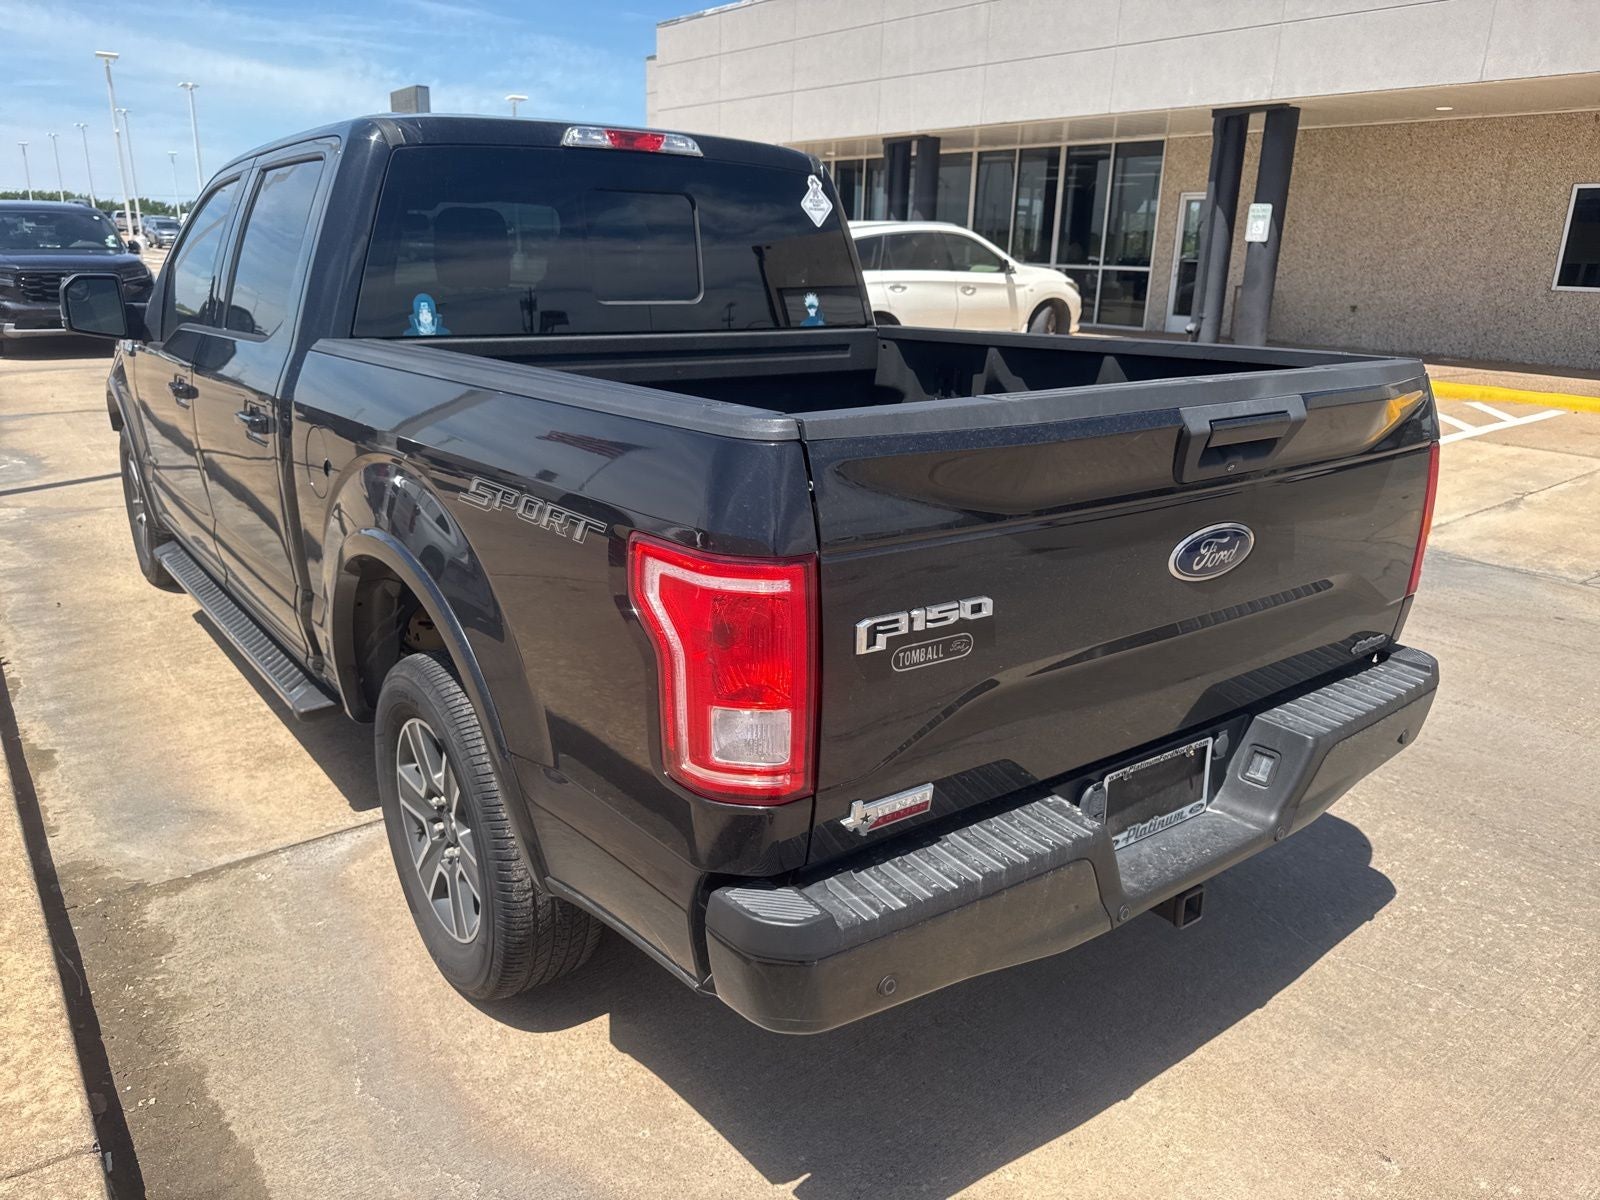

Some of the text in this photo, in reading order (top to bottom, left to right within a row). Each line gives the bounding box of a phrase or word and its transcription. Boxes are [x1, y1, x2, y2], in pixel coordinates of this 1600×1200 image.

[458, 476, 607, 544] SPORT
[1192, 536, 1240, 571] Ford
[898, 643, 944, 667] TOMBALL
[879, 791, 929, 815] TEXAS
[1122, 810, 1185, 844] Platinum
